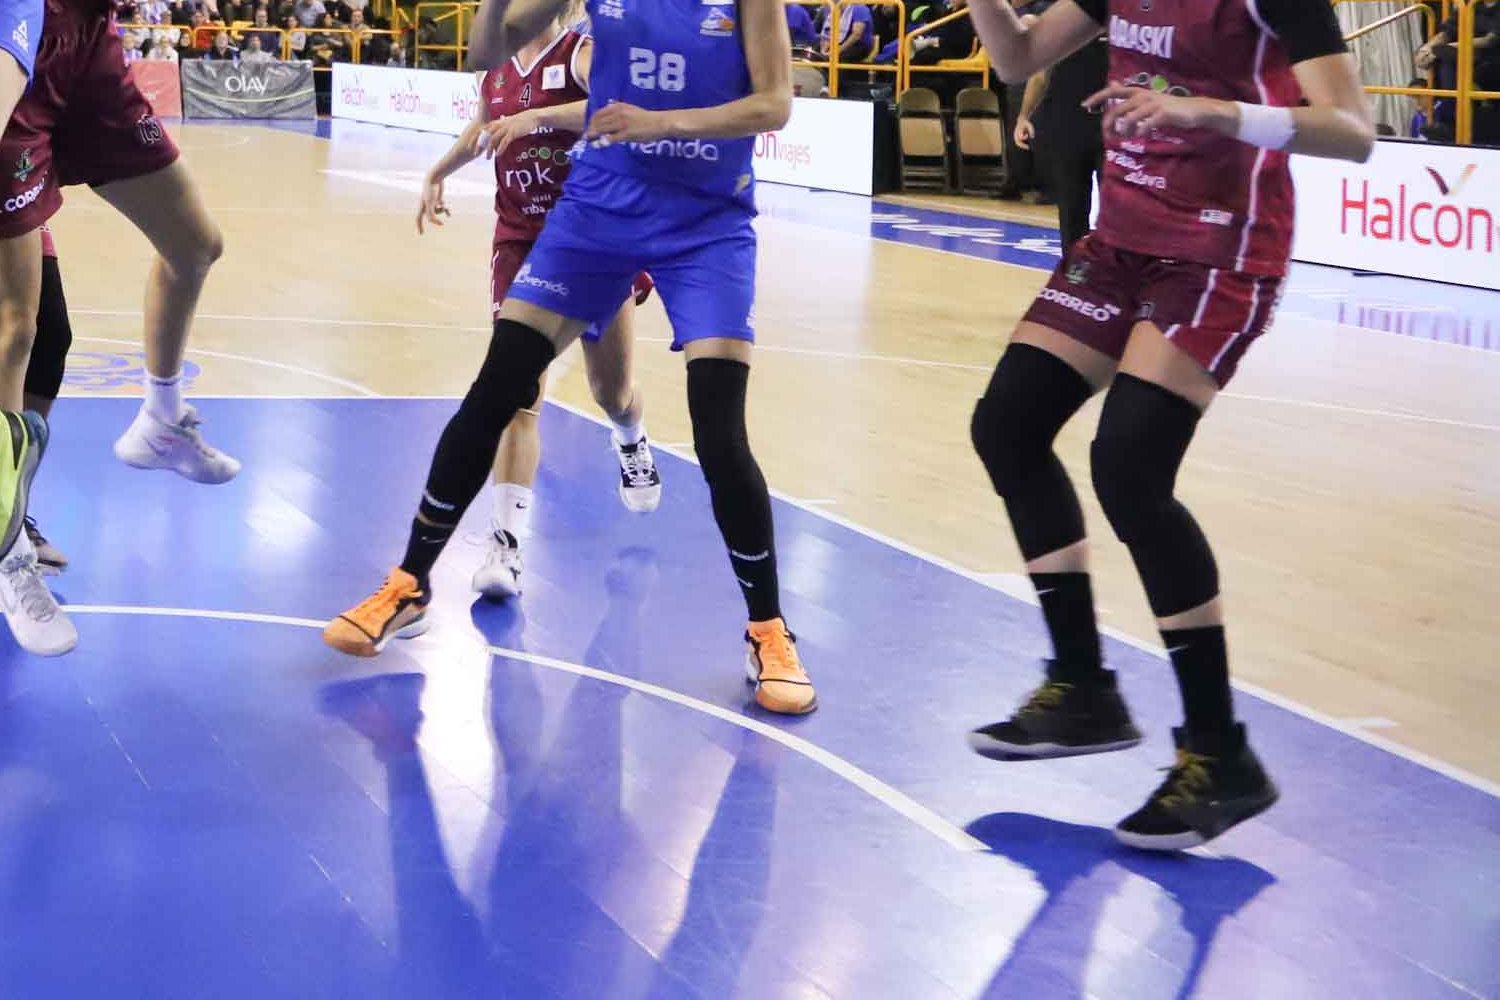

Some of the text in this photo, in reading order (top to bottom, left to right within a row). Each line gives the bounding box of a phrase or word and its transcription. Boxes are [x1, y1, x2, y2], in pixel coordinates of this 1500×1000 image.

[629, 46, 687, 92] 28
[519, 82, 532, 108] 4
[622, 138, 719, 161] venida
[505, 161, 554, 193] rpk
